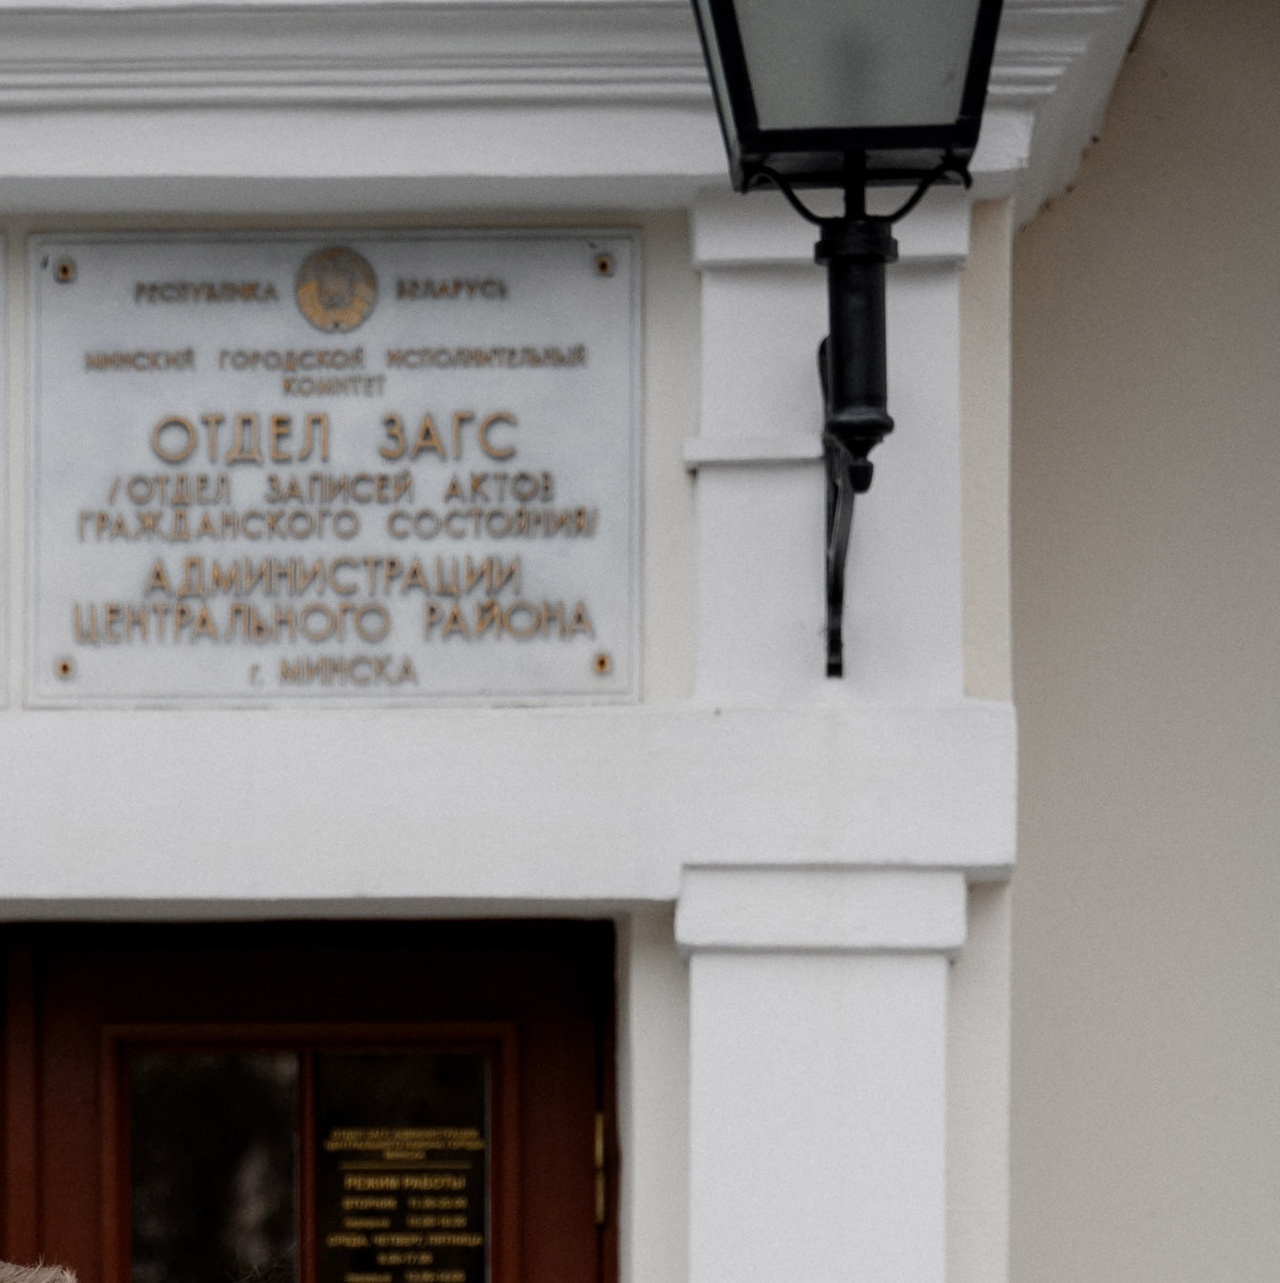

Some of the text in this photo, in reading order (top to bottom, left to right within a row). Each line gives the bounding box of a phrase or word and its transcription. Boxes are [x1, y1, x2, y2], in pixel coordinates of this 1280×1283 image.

[396, 279, 509, 301] БЕЛАРУСЬ
[219, 348, 365, 371] ГОРОДСКОЙ
[151, 413, 518, 464] ОТДЕЛ ЗАГС
[265, 470, 413, 503] ЗАПИСЕЙ
[444, 472, 555, 502] АКТОВ
[78, 510, 359, 542] ГРАЖДАНСКОГО
[145, 557, 520, 599] АДМИНИСТРАЦИИ
[73, 598, 594, 646] ЦЕНТРАЛЬНОГО РАЙОНА
[280, 657, 417, 686] МИНСКА
